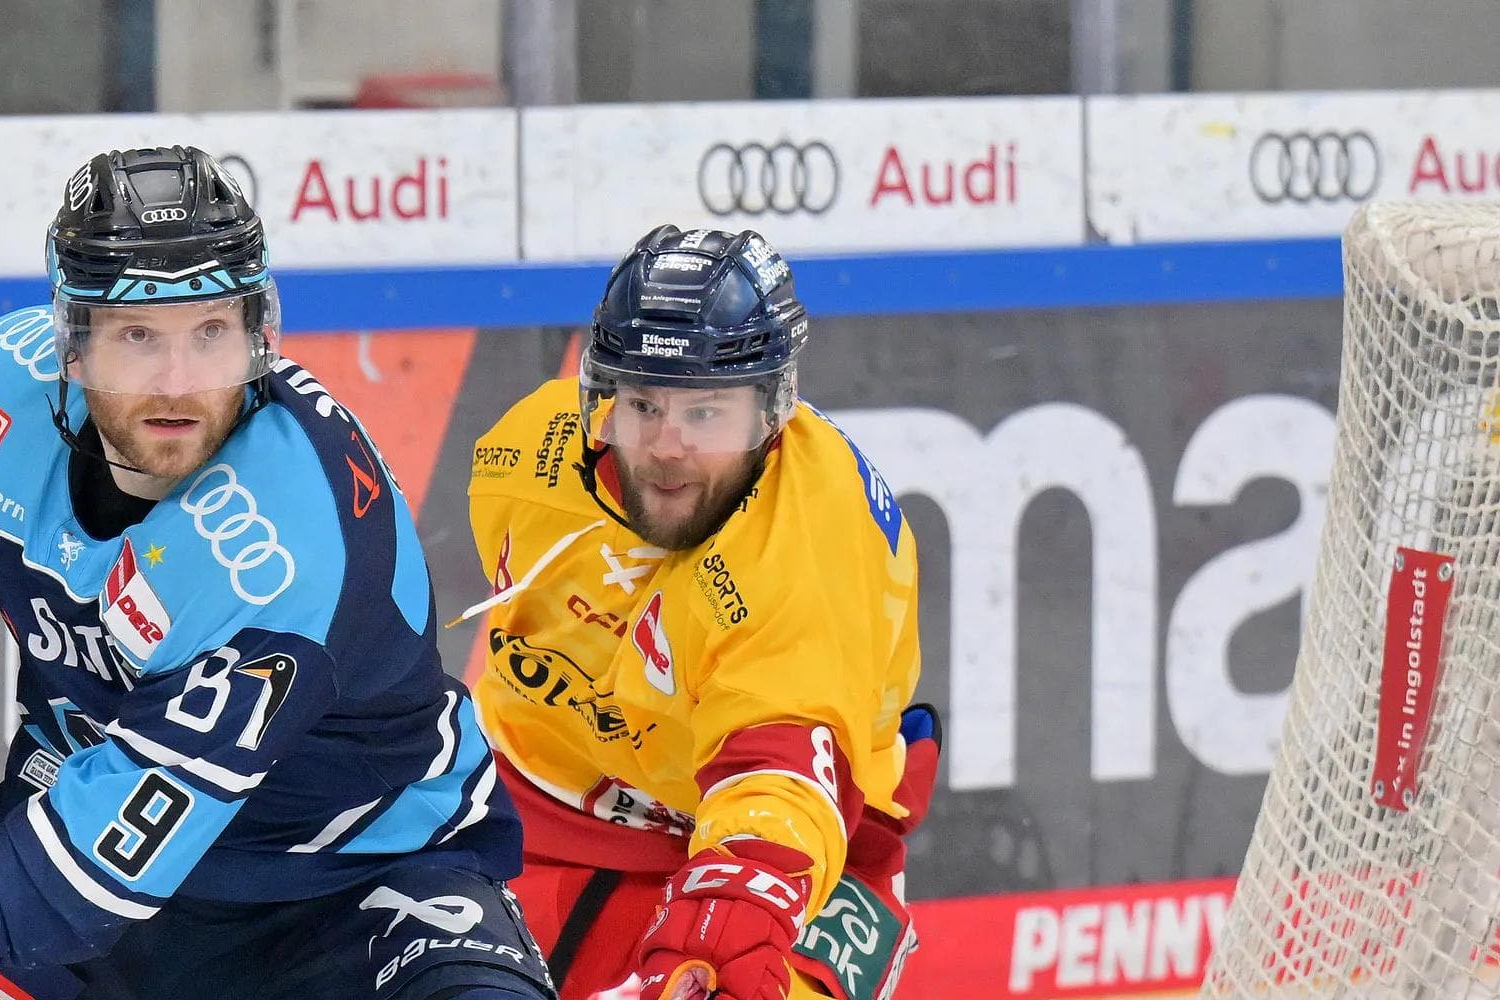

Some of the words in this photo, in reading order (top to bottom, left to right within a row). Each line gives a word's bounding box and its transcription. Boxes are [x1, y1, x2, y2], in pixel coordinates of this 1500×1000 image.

[291, 159, 449, 221] Audi
[870, 144, 1016, 206] Audi
[1411, 137, 1500, 193] Au
[641, 345, 684, 357] Spiegel
[642, 333, 690, 348] Effecten
[534, 411, 568, 479] Spiegel
[703, 553, 749, 625] SPORTS
[1402, 566, 1428, 716] Ingolstadt
[92, 767, 195, 881] 9
